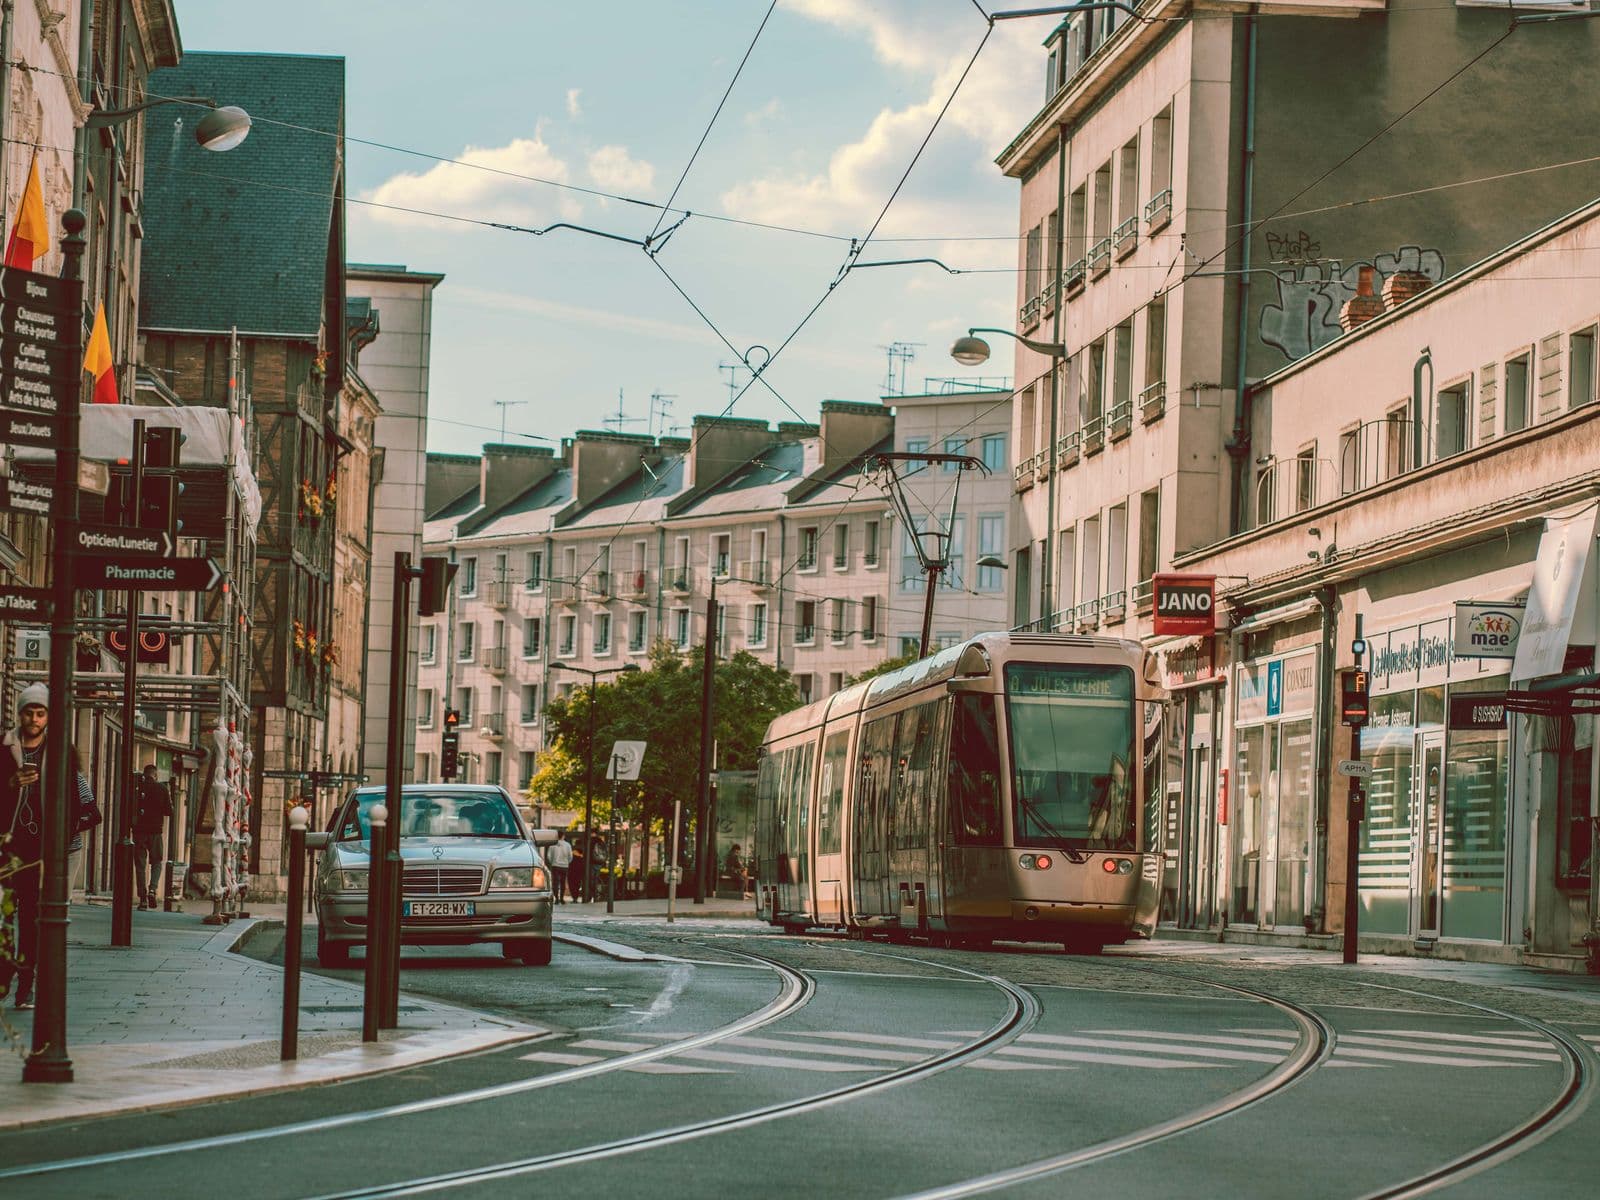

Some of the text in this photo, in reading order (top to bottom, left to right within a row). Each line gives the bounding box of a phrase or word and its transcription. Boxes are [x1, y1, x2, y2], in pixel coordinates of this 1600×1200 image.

[17, 306, 55, 326] Chaussures
[40, 396, 57, 411] table
[79, 532, 158, 551] Opticien/Lunetier
[105, 565, 176, 579] Pharmacie
[1158, 592, 1212, 611] JANO
[1471, 633, 1510, 647] mae
[1011, 675, 1112, 695] A JULES VERNE
[1286, 666, 1313, 693] CONSEIL
